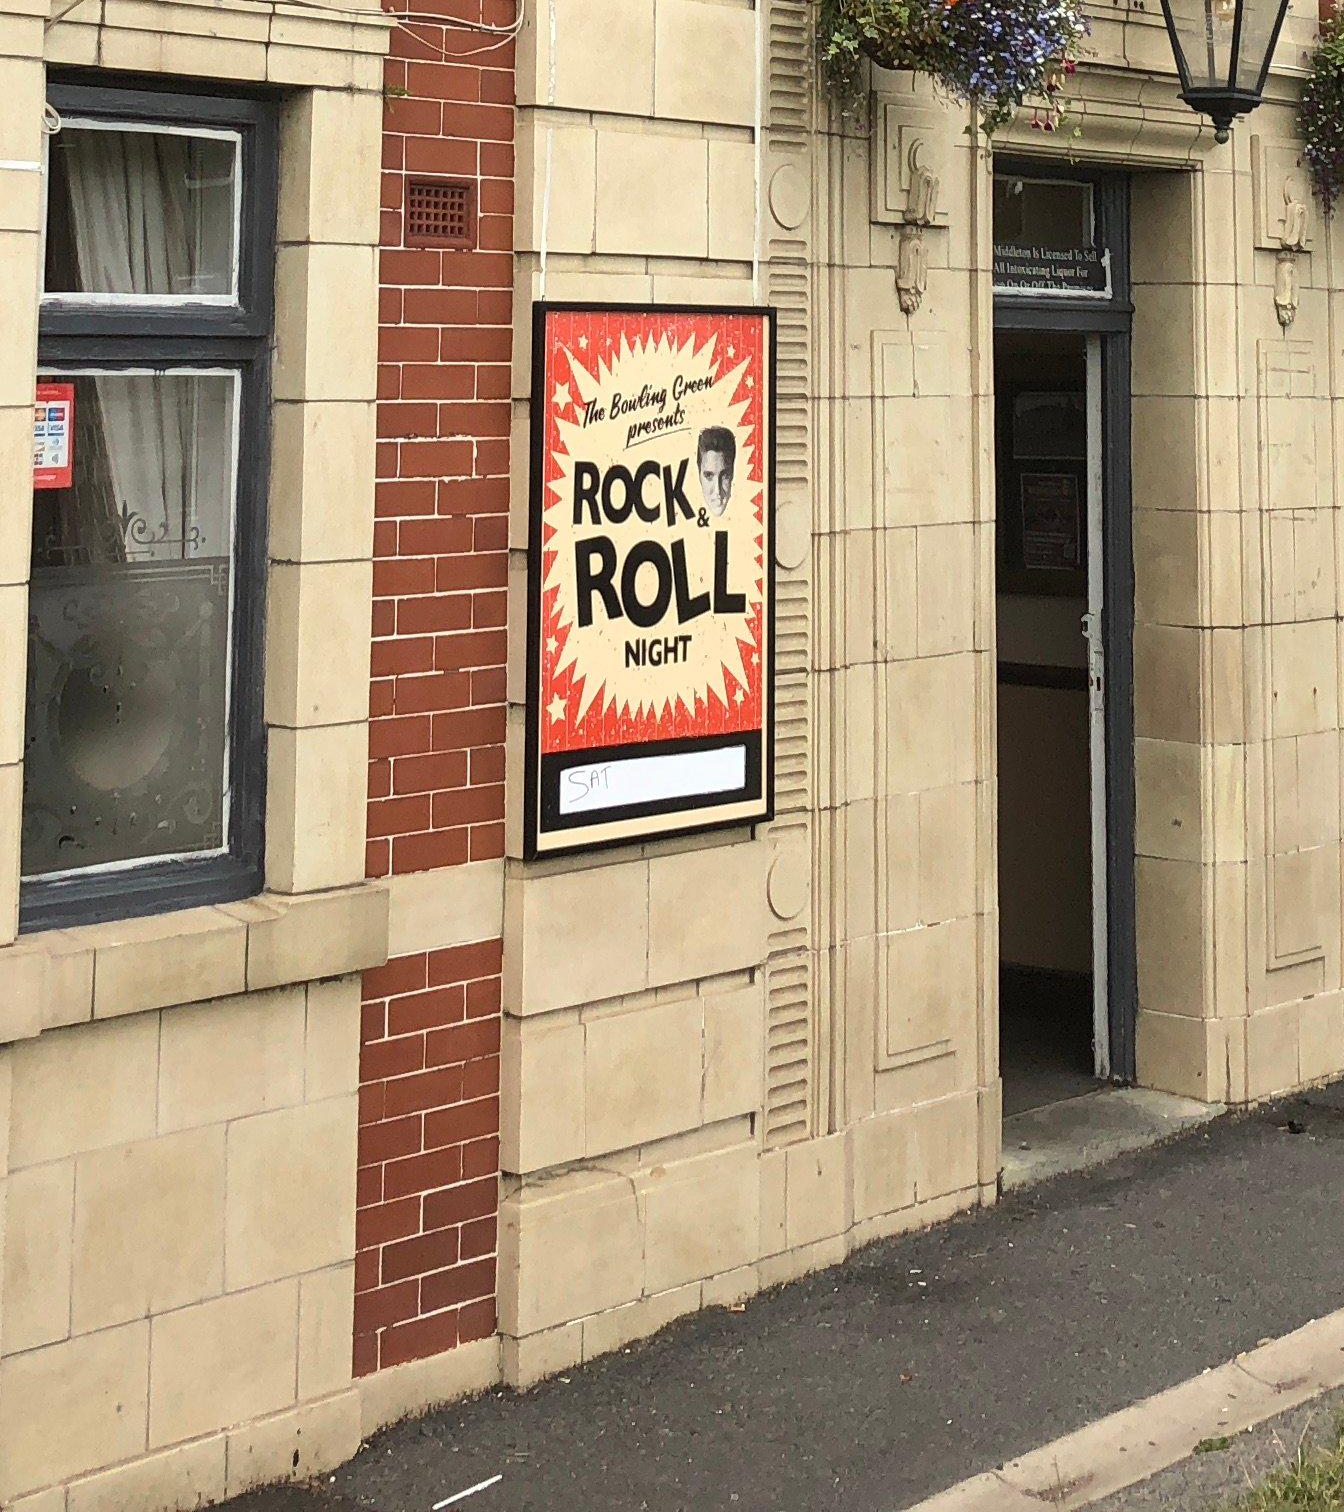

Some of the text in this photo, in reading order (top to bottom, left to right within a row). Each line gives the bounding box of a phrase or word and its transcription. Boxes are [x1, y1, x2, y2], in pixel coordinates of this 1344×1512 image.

[583, 374, 714, 428] The Bowling Green
[626, 403, 685, 448] presents
[572, 457, 710, 528] ROCK &
[575, 530, 746, 628] ROLL
[625, 635, 692, 668] NIGHT
[567, 765, 612, 803] SAT
